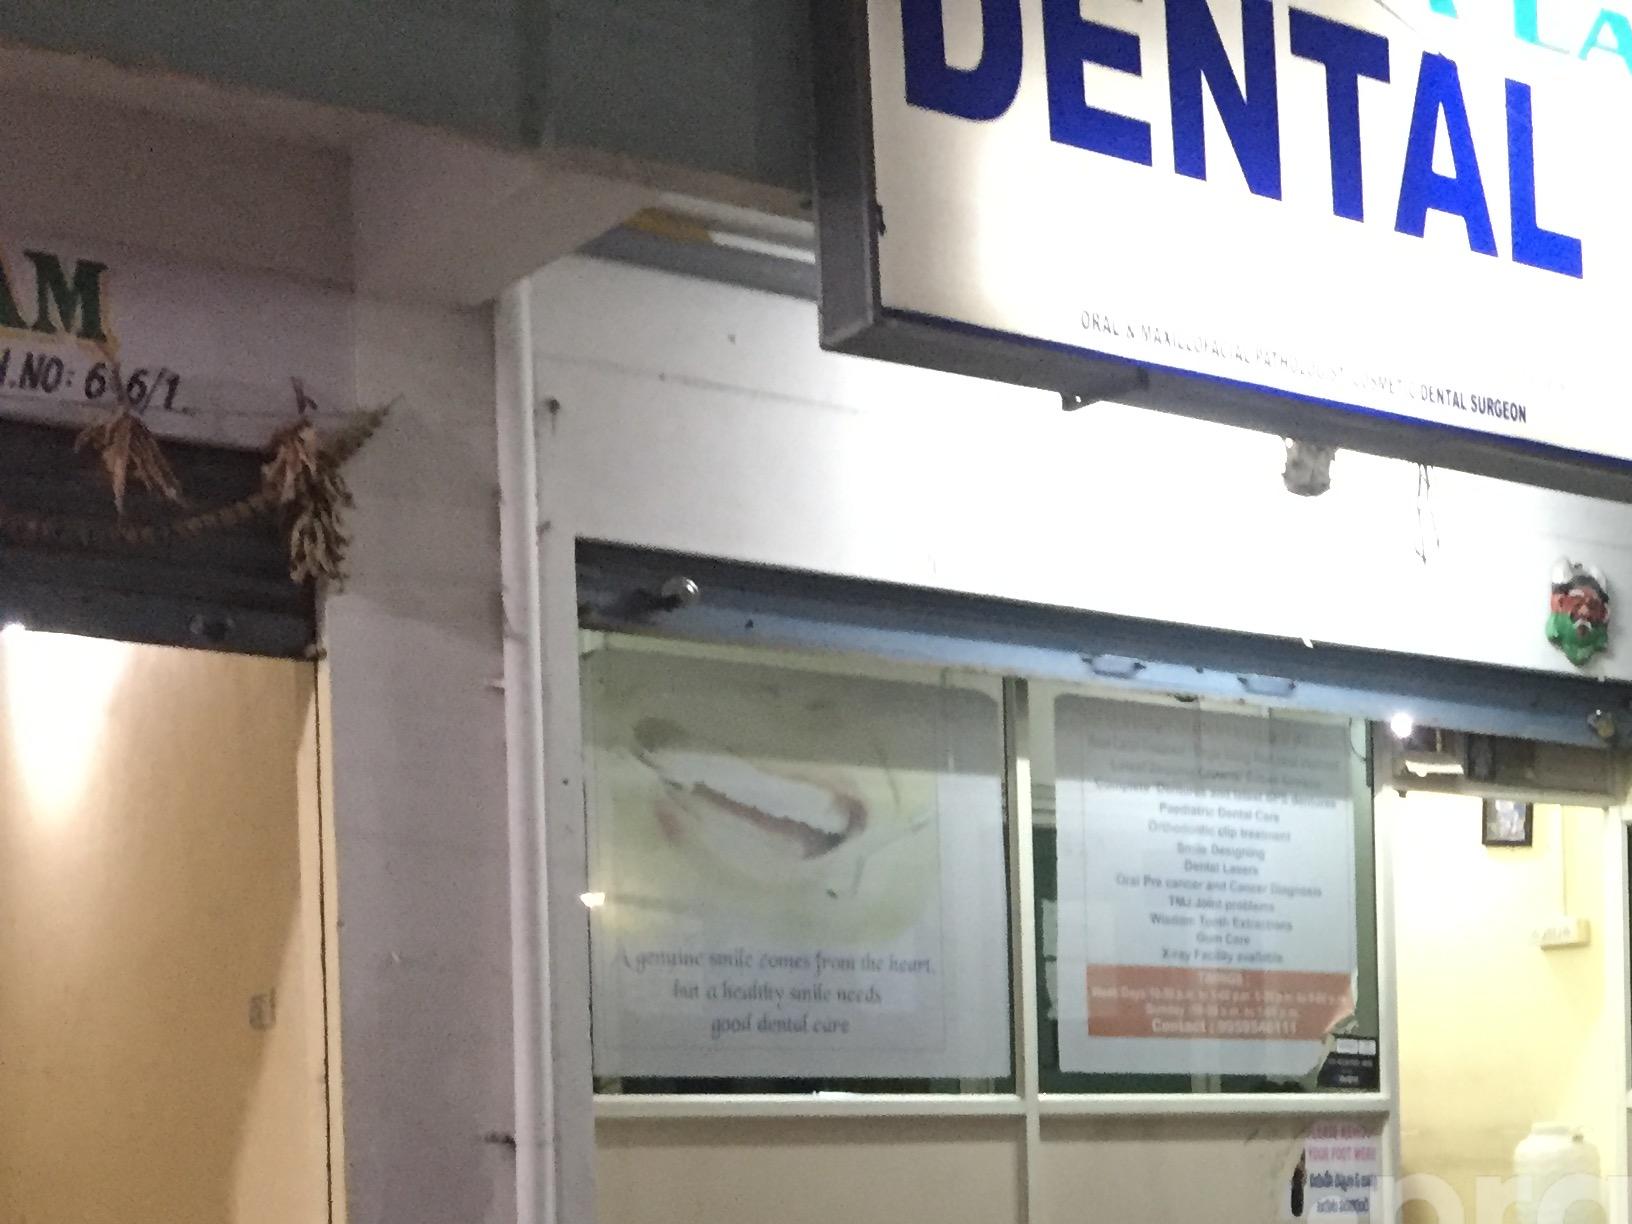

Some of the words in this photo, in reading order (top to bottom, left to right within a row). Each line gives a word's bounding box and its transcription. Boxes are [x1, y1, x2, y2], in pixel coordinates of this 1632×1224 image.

[900, 0, 1583, 279] DENTAL
[1081, 310, 1119, 337] ORAL
[1421, 384, 1466, 410] DENTAL
[1470, 395, 1527, 423] SURGEON
[1218, 806, 1251, 820] Dental
[1184, 859, 1219, 873] Dental
[1206, 879, 1226, 892] and
[708, 947, 753, 968] smile
[815, 949, 855, 977] from
[723, 981, 785, 1010] healthy
[711, 1013, 752, 1040] good
[757, 1014, 808, 1035] dental
